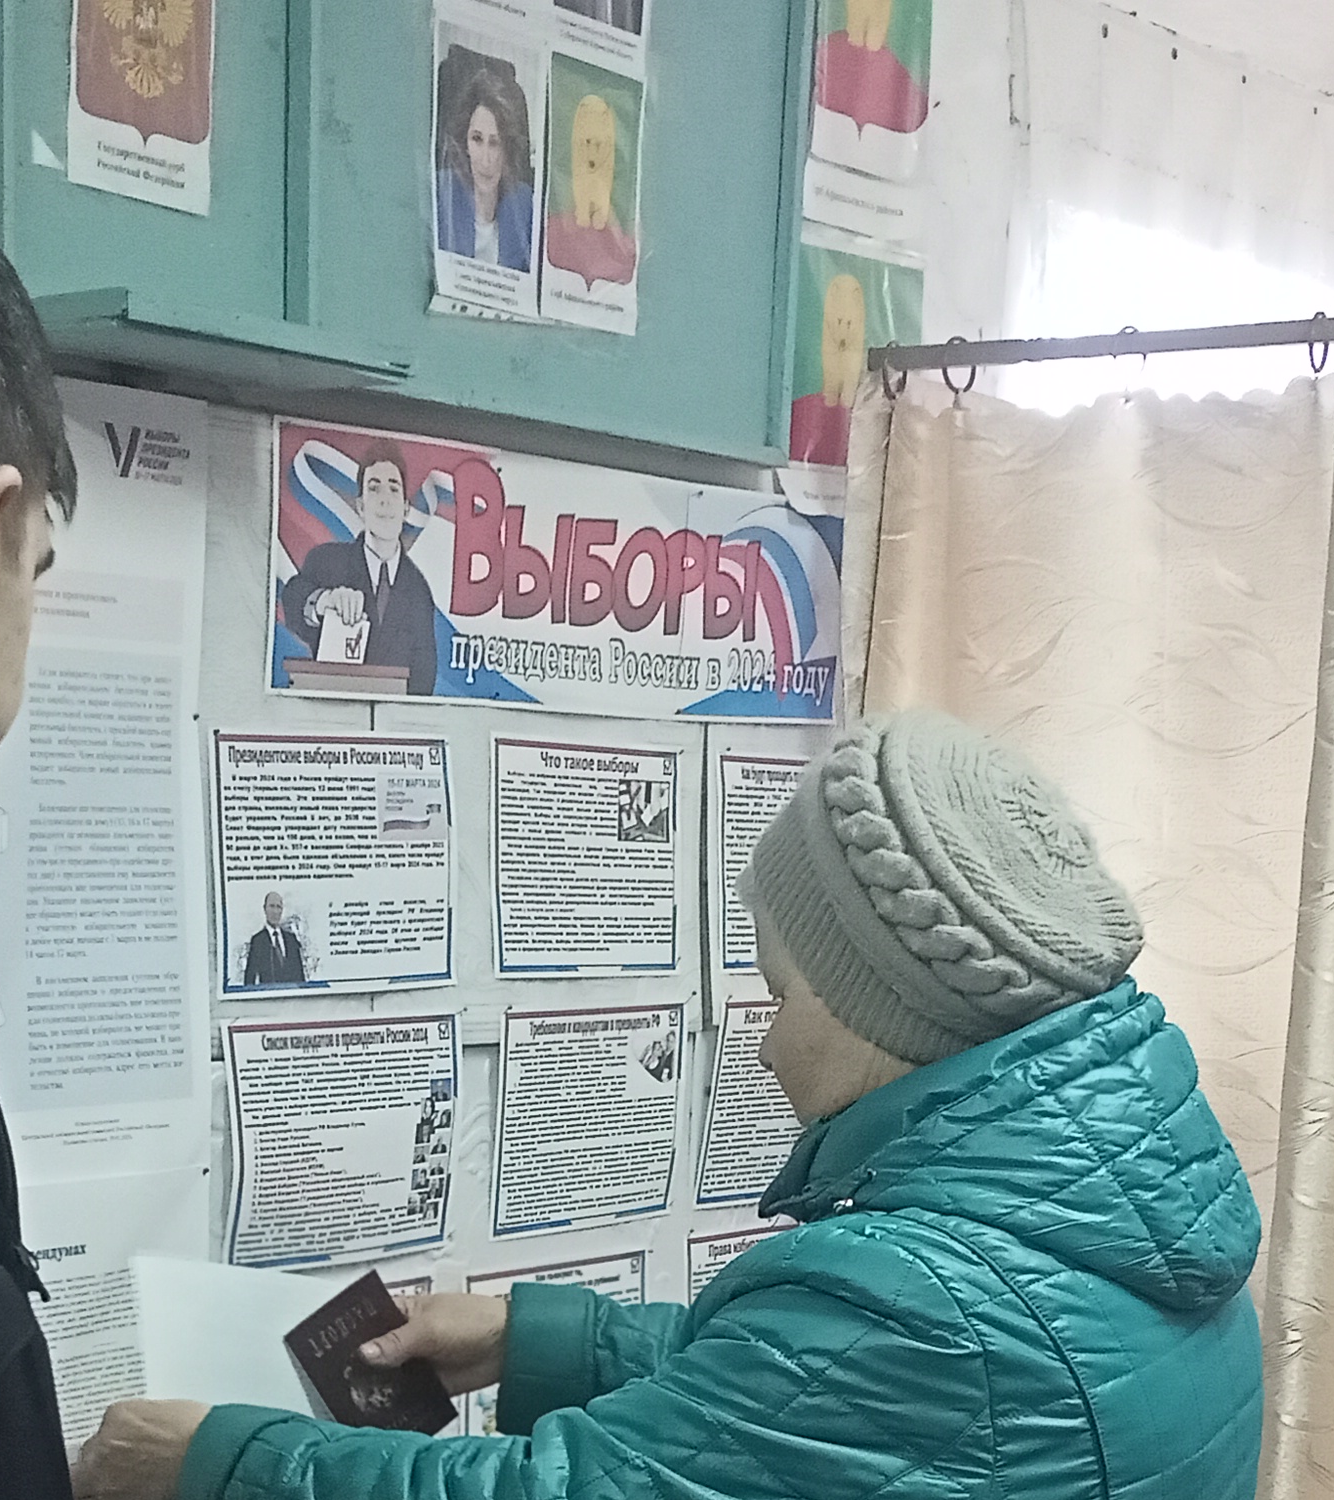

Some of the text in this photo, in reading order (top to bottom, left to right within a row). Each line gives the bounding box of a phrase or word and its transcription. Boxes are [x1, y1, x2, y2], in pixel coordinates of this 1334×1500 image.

[449, 633, 832, 707] президента России в 2024 году
[540, 751, 640, 778] Что такое выборы
